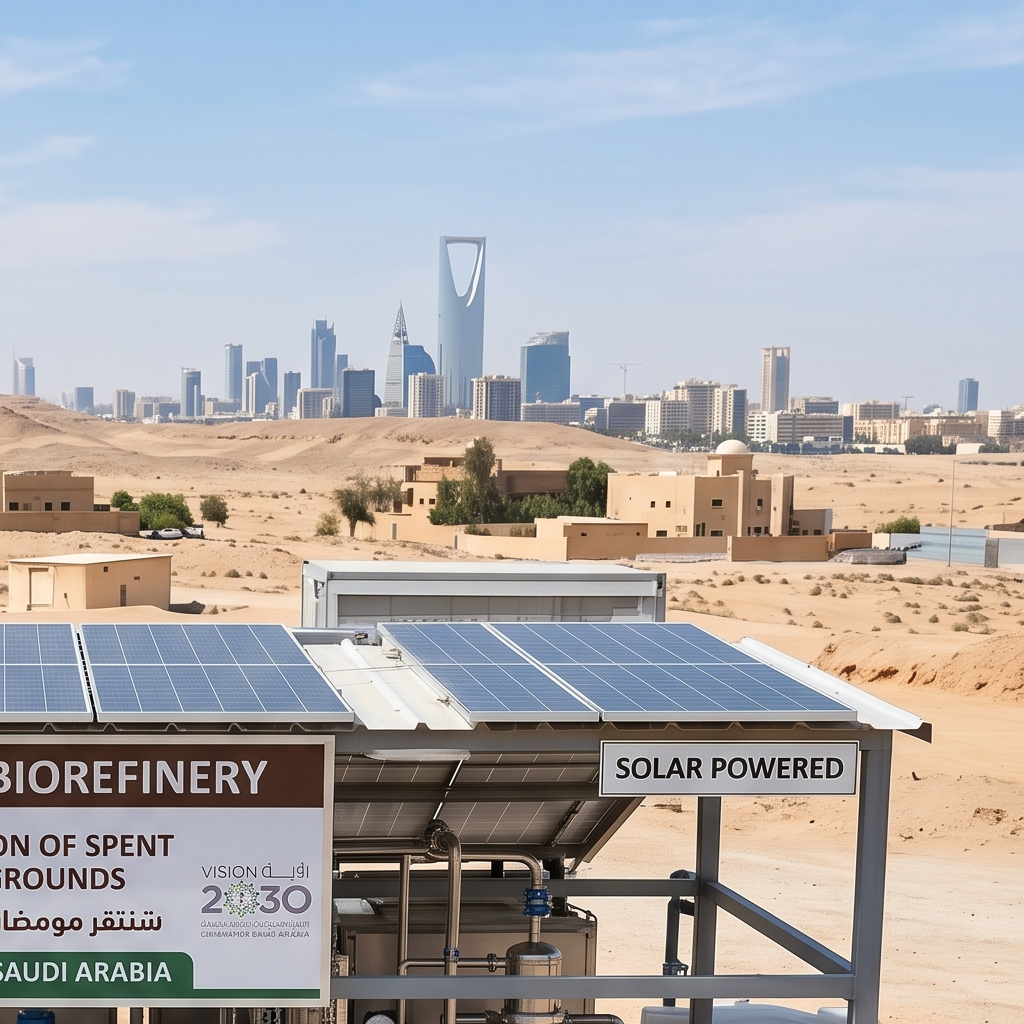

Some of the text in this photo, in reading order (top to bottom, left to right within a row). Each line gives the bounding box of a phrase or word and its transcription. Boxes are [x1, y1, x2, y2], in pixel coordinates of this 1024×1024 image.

[615, 757, 844, 780] SOLAR POWERED
[39, 834, 77, 857] OF
[85, 834, 175, 857] SPENT
[201, 865, 257, 879] VISION
[74, 961, 172, 982] ARABIA
